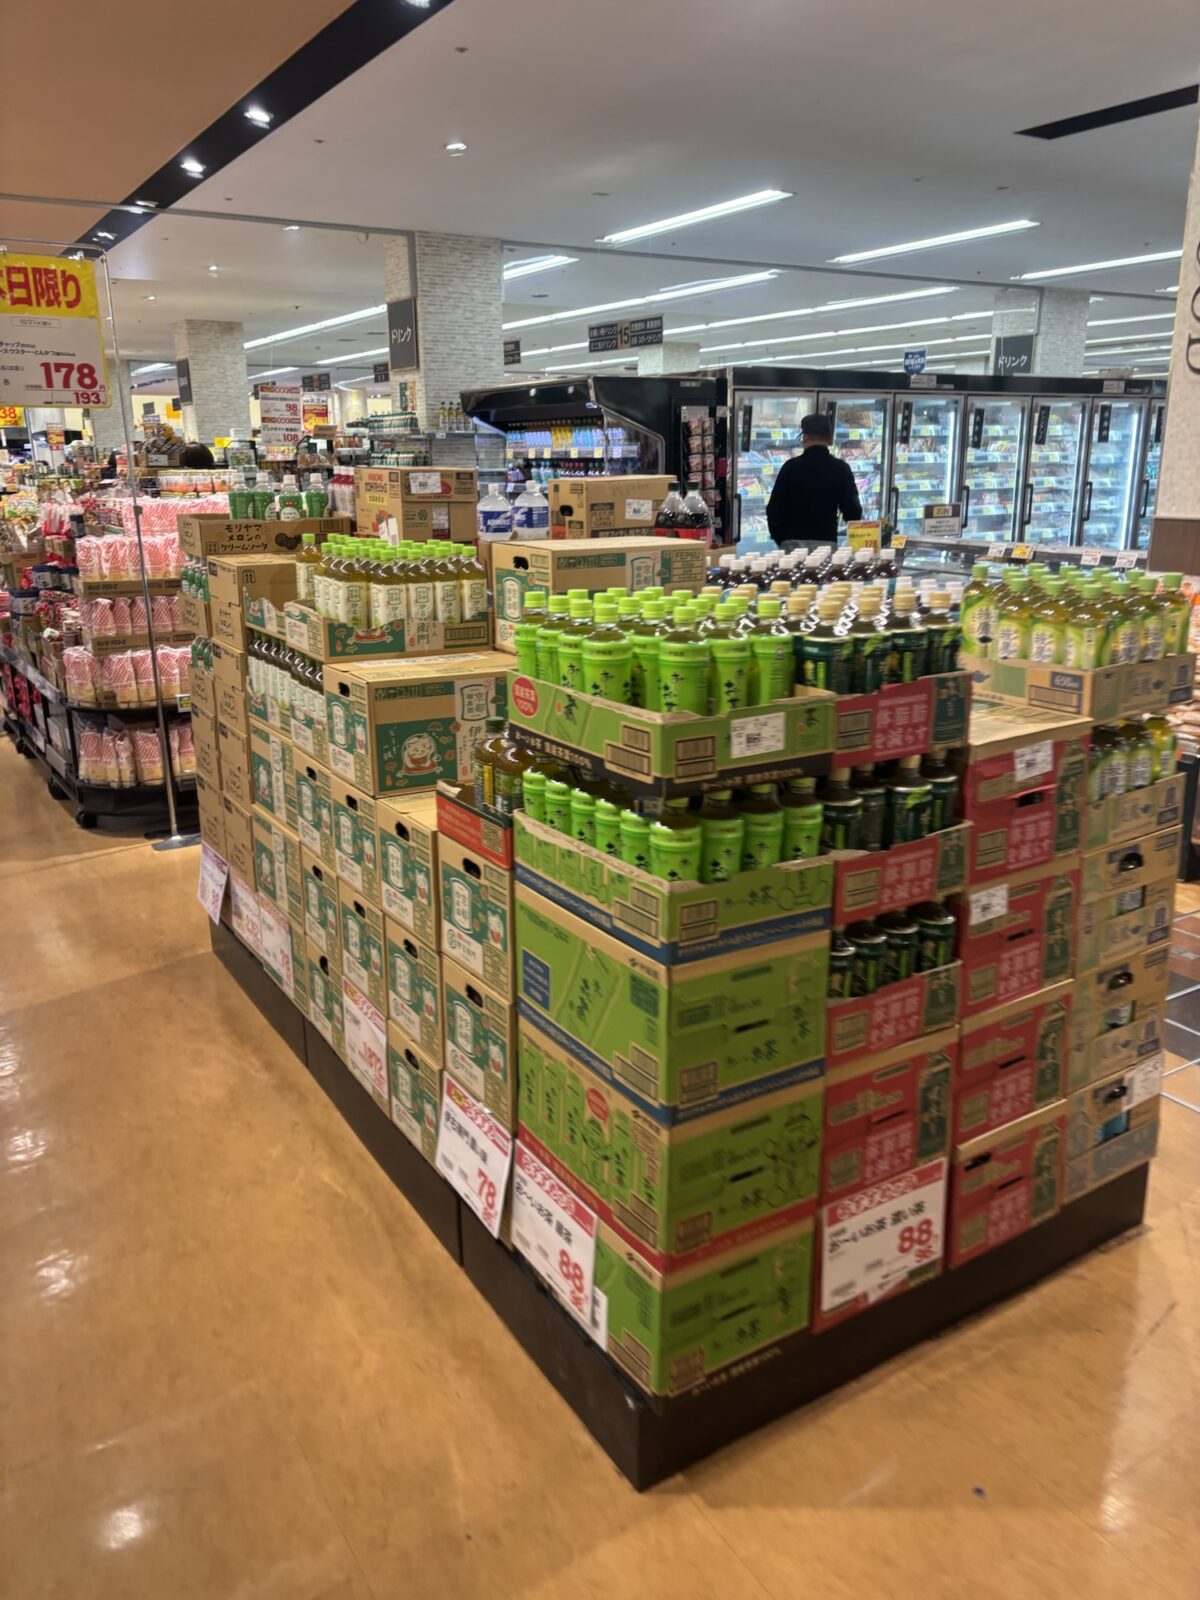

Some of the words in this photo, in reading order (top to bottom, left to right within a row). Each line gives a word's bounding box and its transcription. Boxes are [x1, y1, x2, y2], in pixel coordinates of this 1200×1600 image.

[391, 326, 412, 344] ドリンク
[618, 326, 630, 345] 15
[998, 355, 1028, 368] ドリンク
[40, 362, 98, 390] 178
[73, 392, 101, 404] 193
[225, 524, 263, 532] モリヤマ
[227, 534, 262, 542] メロンの
[477, 1167, 497, 1210] 78
[897, 1218, 934, 1254] 88
[558, 1248, 585, 1295] 88
